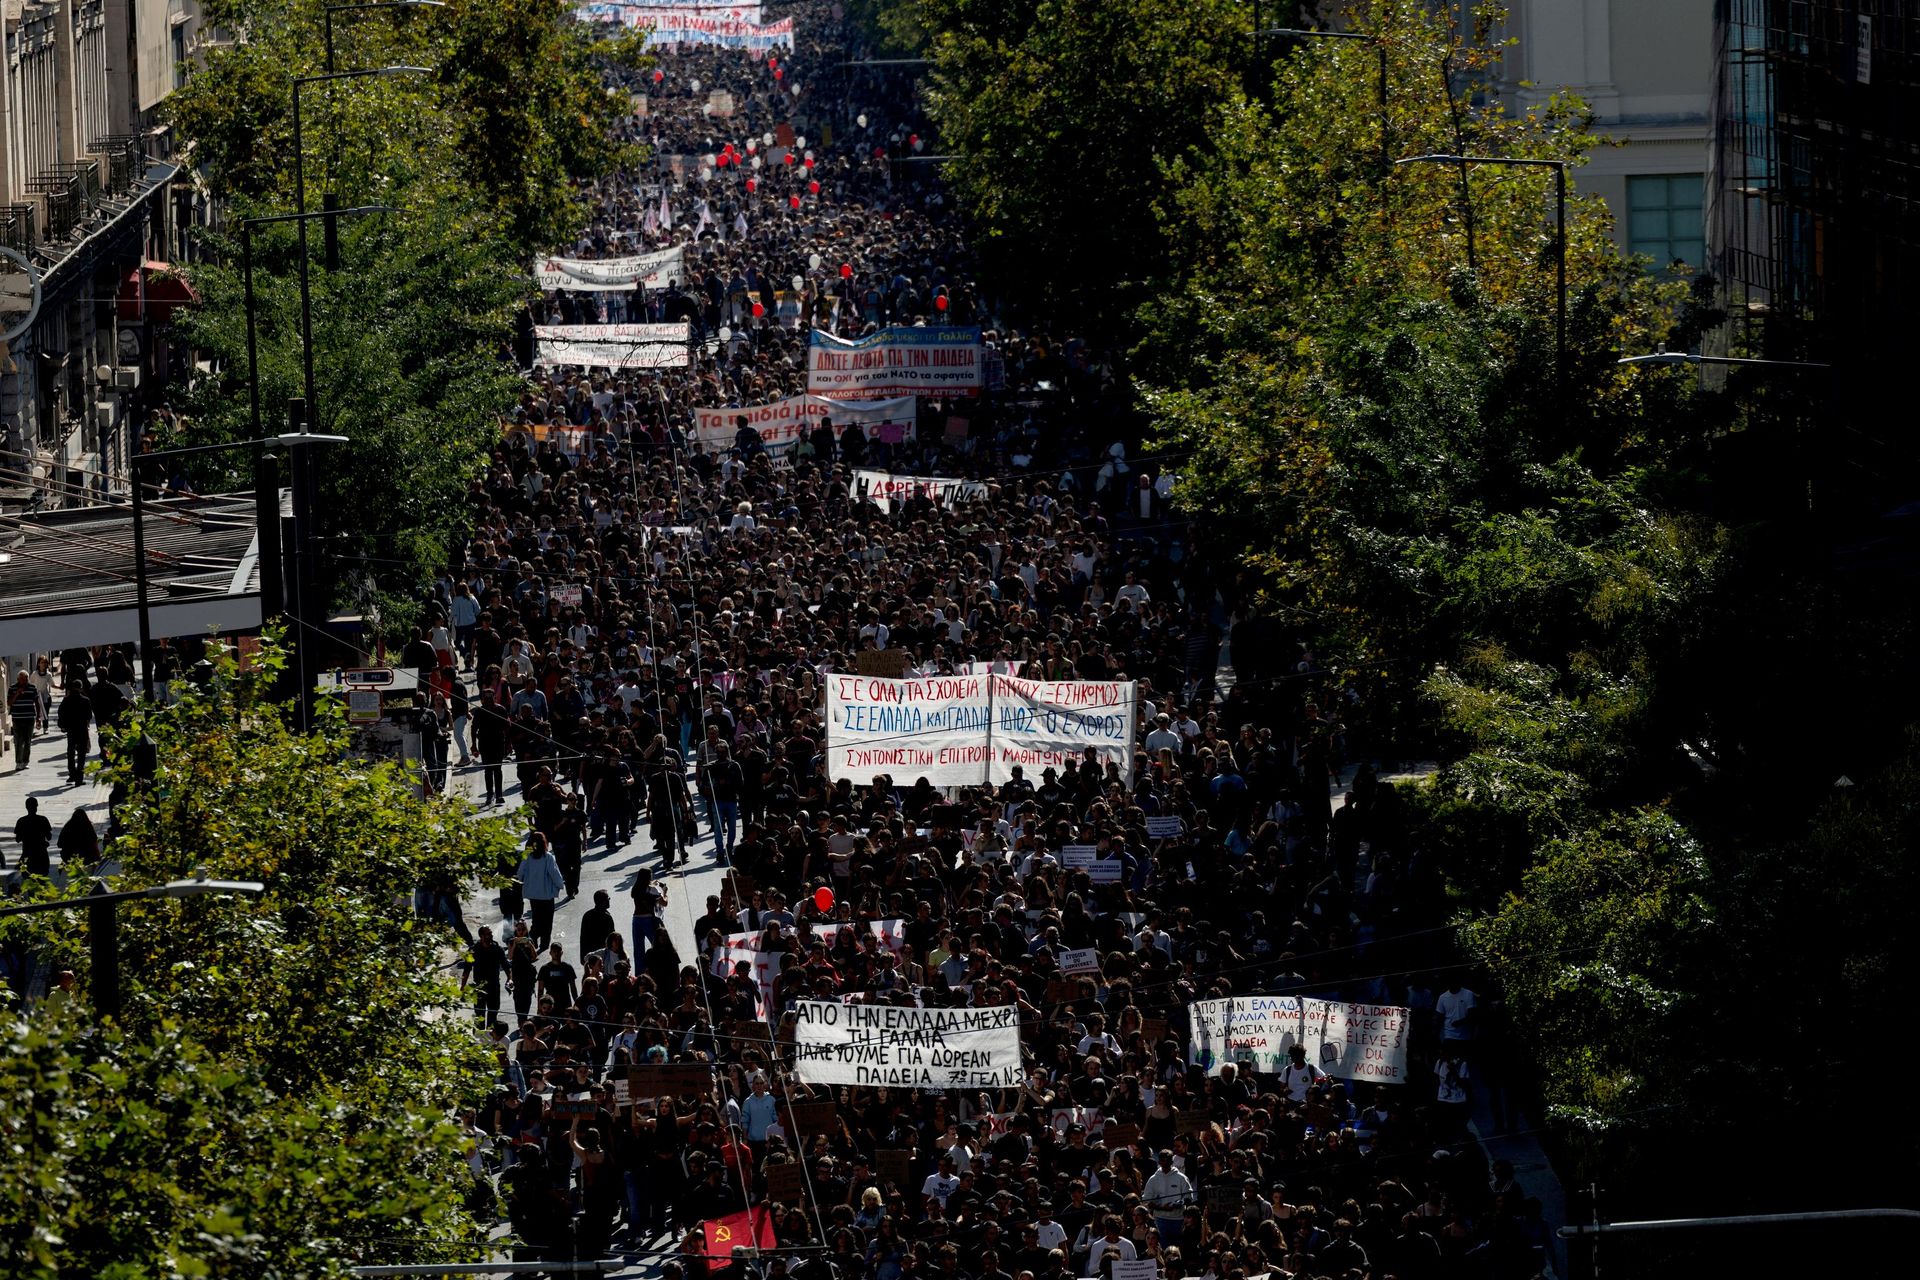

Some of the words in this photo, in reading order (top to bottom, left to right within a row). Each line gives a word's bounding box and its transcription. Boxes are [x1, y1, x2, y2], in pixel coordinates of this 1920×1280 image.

[661, 15, 682, 30] ΤΗΝ
[937, 331, 973, 342] Γαλλία
[817, 352, 848, 371] ΔΩΣΤΕ
[852, 350, 884, 370] ΛΕΦΤΑ
[888, 349, 903, 368] ΓΙΑ
[907, 349, 929, 367] ΤΗΝ
[933, 349, 974, 367] ΠΑΙΔΕΙΑ
[855, 374, 870, 383] για
[700, 414, 722, 428] Τα
[795, 403, 829, 420] μας
[840, 677, 863, 702] ΣΕ
[869, 680, 897, 702] ΟΛΑ
[904, 681, 924, 702] ΤΑ
[926, 678, 979, 701] ΣΧΟΛΕΙΑ
[986, 675, 1041, 700] ΠΑΝΤΟΥ
[844, 705, 867, 731] ΣΕ
[868, 705, 921, 732] ΕΛΛΑΔΑ
[926, 711, 946, 727] ΚΑΙ
[947, 706, 991, 732] ΓΑΛΛΙΑ
[1000, 706, 1038, 733] ΙΔΙΟΣ
[1046, 709, 1057, 734] Ο
[1062, 712, 1127, 740] ΕΧΘΡΟΣ
[846, 748, 933, 767] ΣΥΝΤΟΝΙΣΤΙΚΗ
[939, 745, 996, 765] ΕΠΙΤΡΟΠΗ
[1002, 747, 1062, 765] ΜΑΘΗΤΩΝ
[1193, 1001, 1216, 1014] ΑΠΟ
[1219, 1000, 1245, 1012] ΤΗΝ
[1306, 1001, 1344, 1014] ΜΕΧΡΙ
[796, 1003, 838, 1026] ΑΠΟ
[842, 1004, 879, 1028] ΤΗΝ
[885, 1008, 960, 1031] ΕΛΛΑΔΑ
[963, 1008, 1017, 1030] ΜΕΧΡΙ
[1193, 1015, 1216, 1027] ΤΗΝ
[1345, 1018, 1378, 1030] AVEC
[1383, 1019, 1407, 1033] LES
[846, 1028, 870, 1047] ΤΗ
[879, 1029, 946, 1048] ΓΑΛΛΙΑ
[1195, 1030, 1213, 1041] ΓΙΑ
[1215, 1024, 1265, 1038] ΔΗΜΟΣΙΑ
[1268, 1024, 1285, 1034] ΚΑΙ
[1224, 1037, 1267, 1049] ΠΑΙΔΕΙΑ
[898, 1047, 922, 1065] ΓΙΑ
[931, 1048, 991, 1068] ΔΩΡΕΑΝ
[1365, 1047, 1384, 1060] DU
[856, 1066, 932, 1084] ΠΑΙΔΕΙΑ
[970, 1071, 1000, 1086] ΓΕΛ
[1354, 1063, 1399, 1077] MONDE
